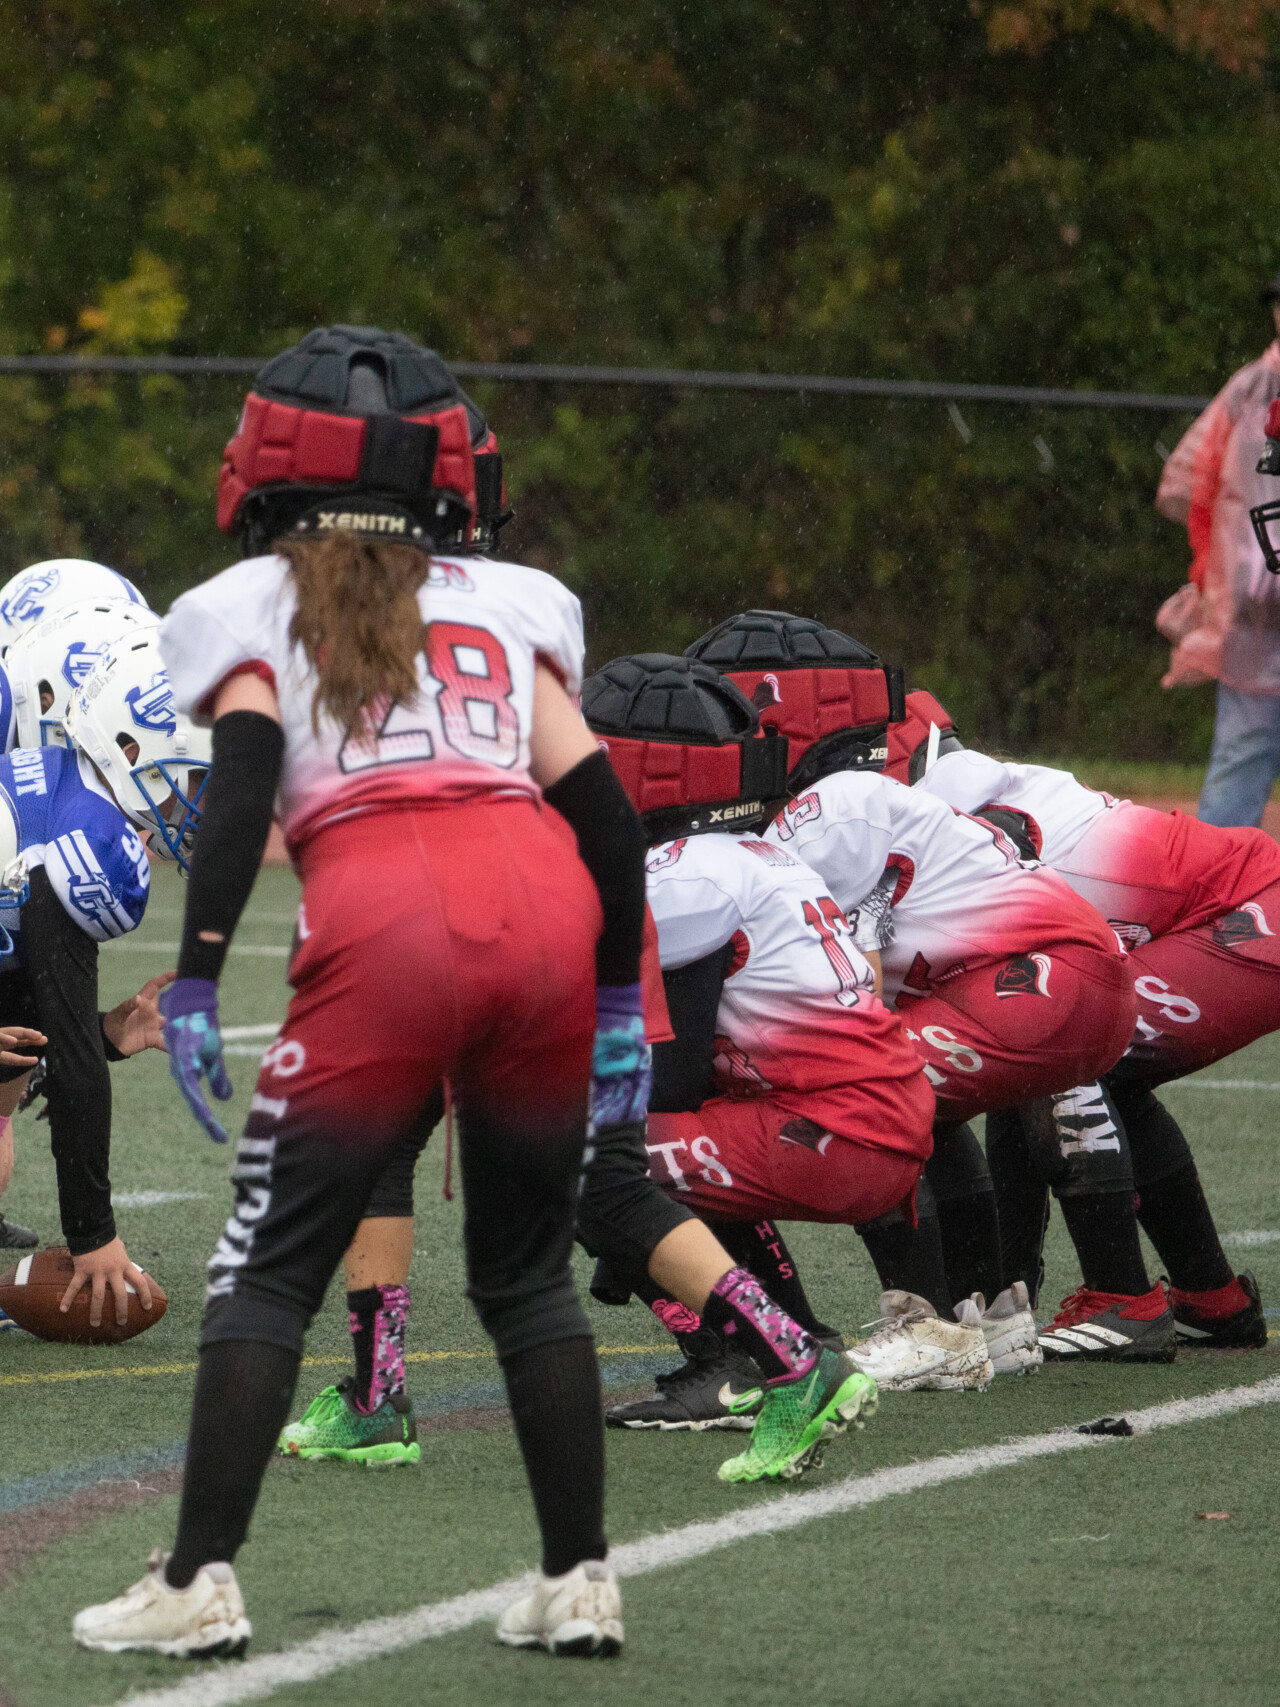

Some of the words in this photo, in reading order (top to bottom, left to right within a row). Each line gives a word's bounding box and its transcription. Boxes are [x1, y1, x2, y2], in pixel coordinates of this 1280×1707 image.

[318, 513, 405, 533] XENITH
[708, 800, 761, 823] XENITH
[754, 1220, 794, 1280] HTS
